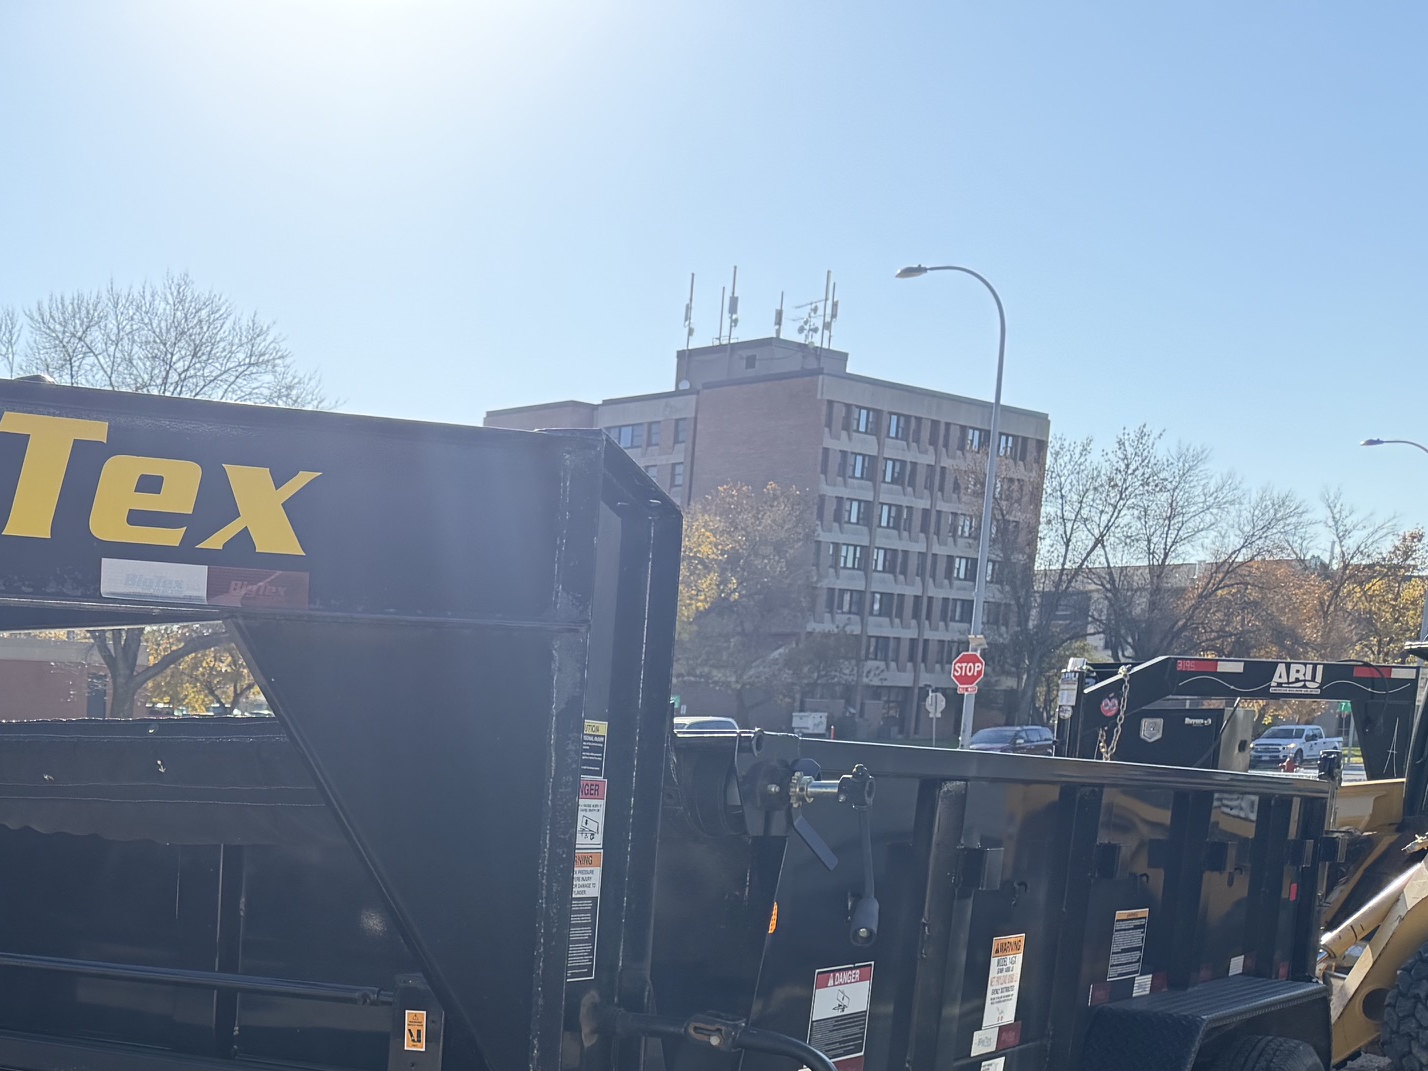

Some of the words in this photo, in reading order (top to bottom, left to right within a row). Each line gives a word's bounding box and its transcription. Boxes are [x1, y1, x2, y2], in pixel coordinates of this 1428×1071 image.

[954, 663, 982, 676] STOP
[1271, 662, 1323, 688] ABU
[581, 783, 600, 796] NGER
[834, 969, 860, 985] DANGER
